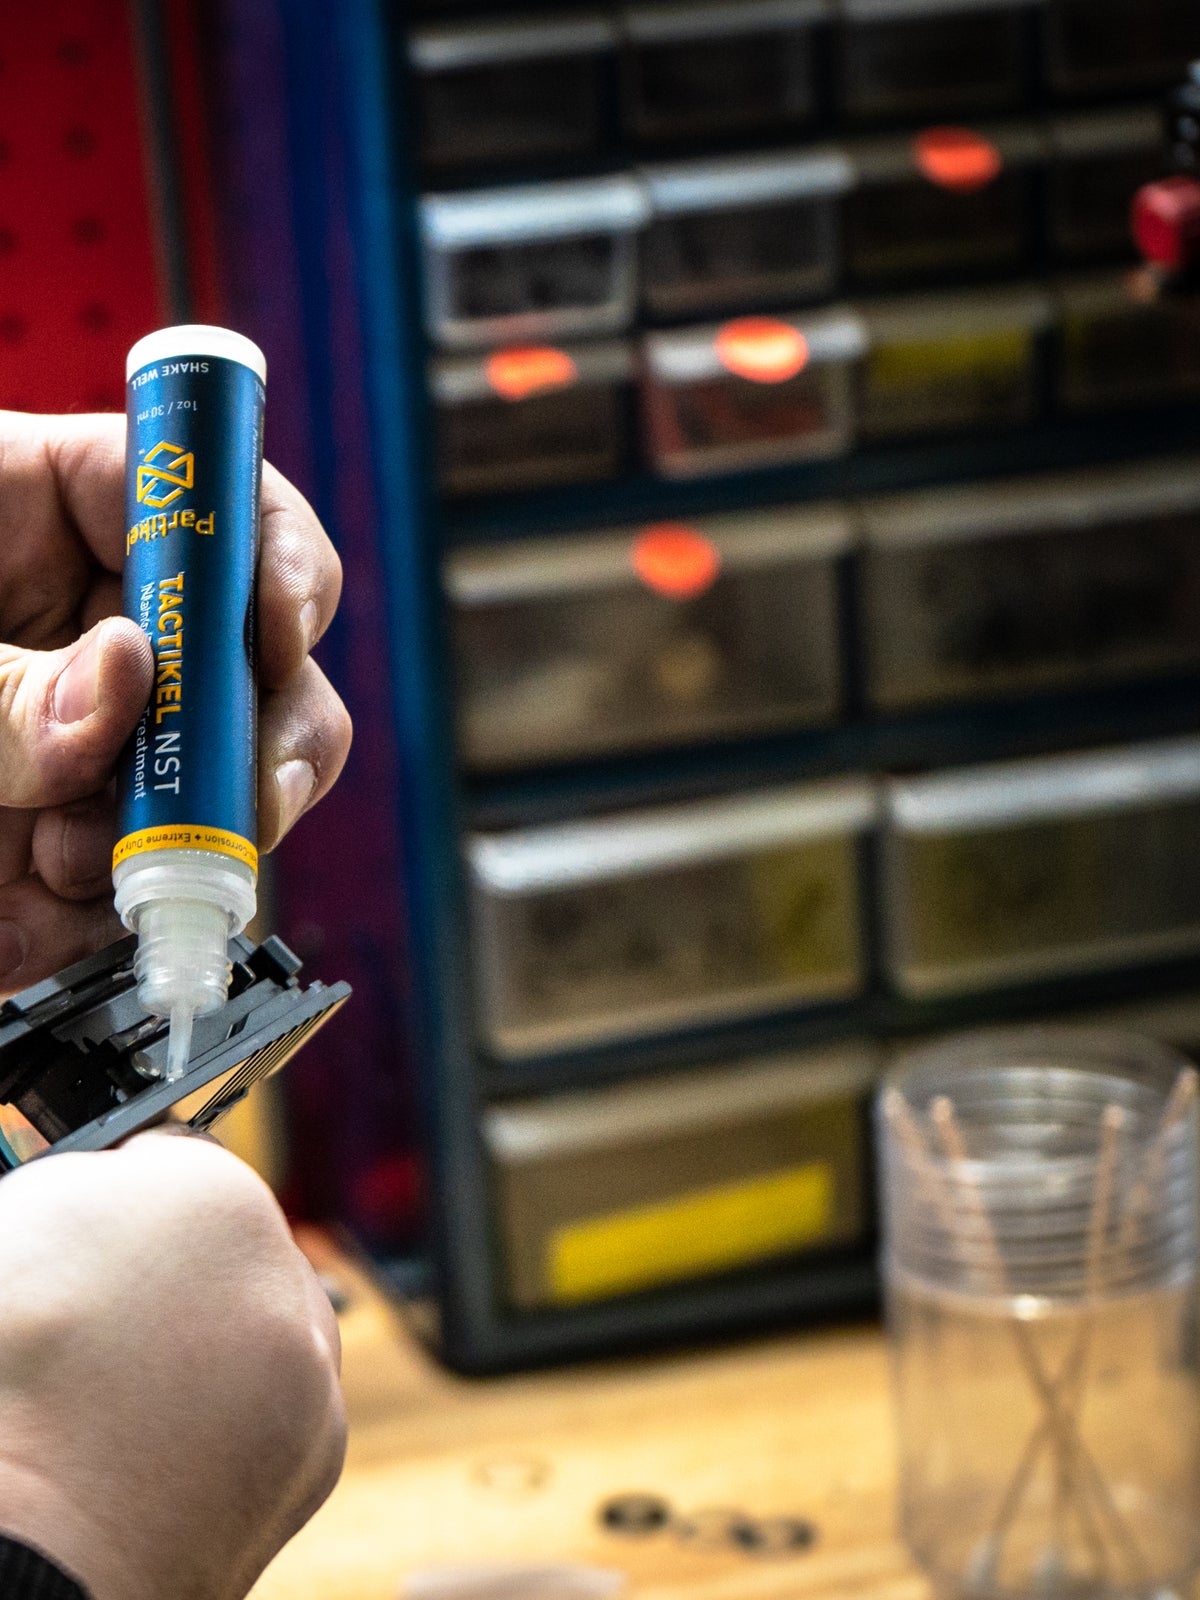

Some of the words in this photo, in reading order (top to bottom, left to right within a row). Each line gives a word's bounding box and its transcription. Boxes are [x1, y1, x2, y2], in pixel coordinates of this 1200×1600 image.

[161, 362, 210, 377] SHAKE
[131, 371, 159, 391] WELL
[151, 405, 165, 418] 30
[176, 400, 198, 411] 1oz
[136, 410, 149, 425] ml
[126, 509, 216, 557] Partikel
[156, 571, 185, 724] TACTIKEL
[134, 706, 150, 801] Treatment
[153, 731, 181, 795] NST
[124, 837, 143, 849] Duty
[145, 832, 191, 844] Extreme
